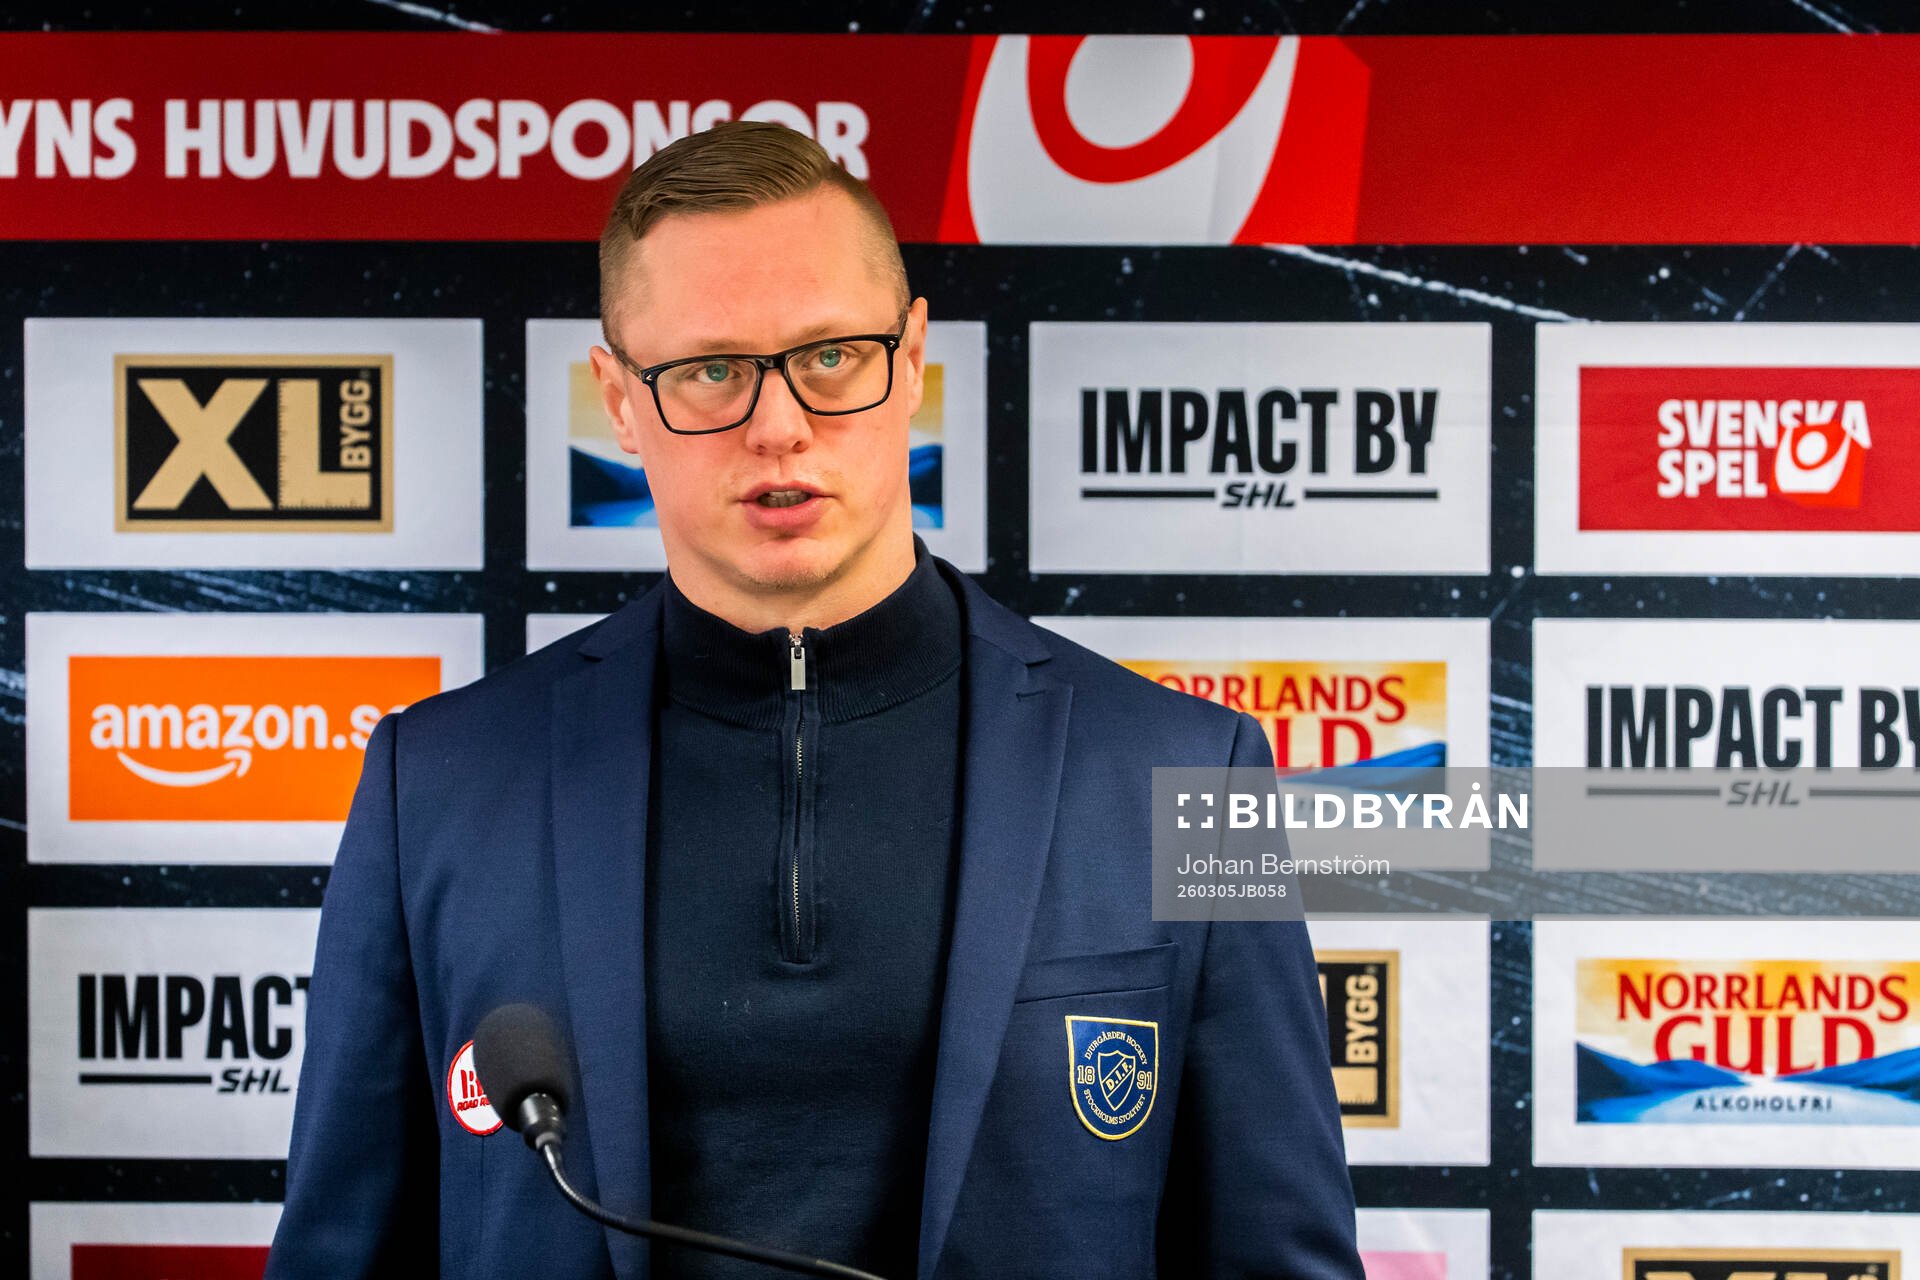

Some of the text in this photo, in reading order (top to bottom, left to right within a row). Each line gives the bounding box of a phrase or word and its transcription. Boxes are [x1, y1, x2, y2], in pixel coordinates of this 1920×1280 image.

[132, 378, 372, 511] XL
[339, 379, 372, 468] BYGG
[1080, 388, 1439, 475] IMPACT BY
[1657, 399, 1872, 450] SVENSKA
[1221, 482, 1296, 508] SHL
[1657, 448, 1768, 498] SPEL
[90, 704, 406, 750] amazon.s
[1266, 717, 1374, 777] LD
[1586, 685, 1843, 771] IMPACT
[1727, 780, 1800, 806] SHL
[79, 975, 311, 1059] IMPAC
[1345, 975, 1379, 1064] BYGG
[1616, 972, 1909, 1023] NORRLANDS
[1084, 1031, 1148, 1065] DJURGÅRDEN HOCKEY
[1653, 1013, 1875, 1077] GULD
[218, 1068, 290, 1094] SHL
[1077, 1065, 1095, 1085] 18
[1137, 1070, 1153, 1090] 91
[457, 1099, 479, 1111] ROAD
[1083, 1088, 1146, 1124] STOCKHOLMS STOLTHET
[1693, 1096, 1833, 1112] ALKOHOLFRI
